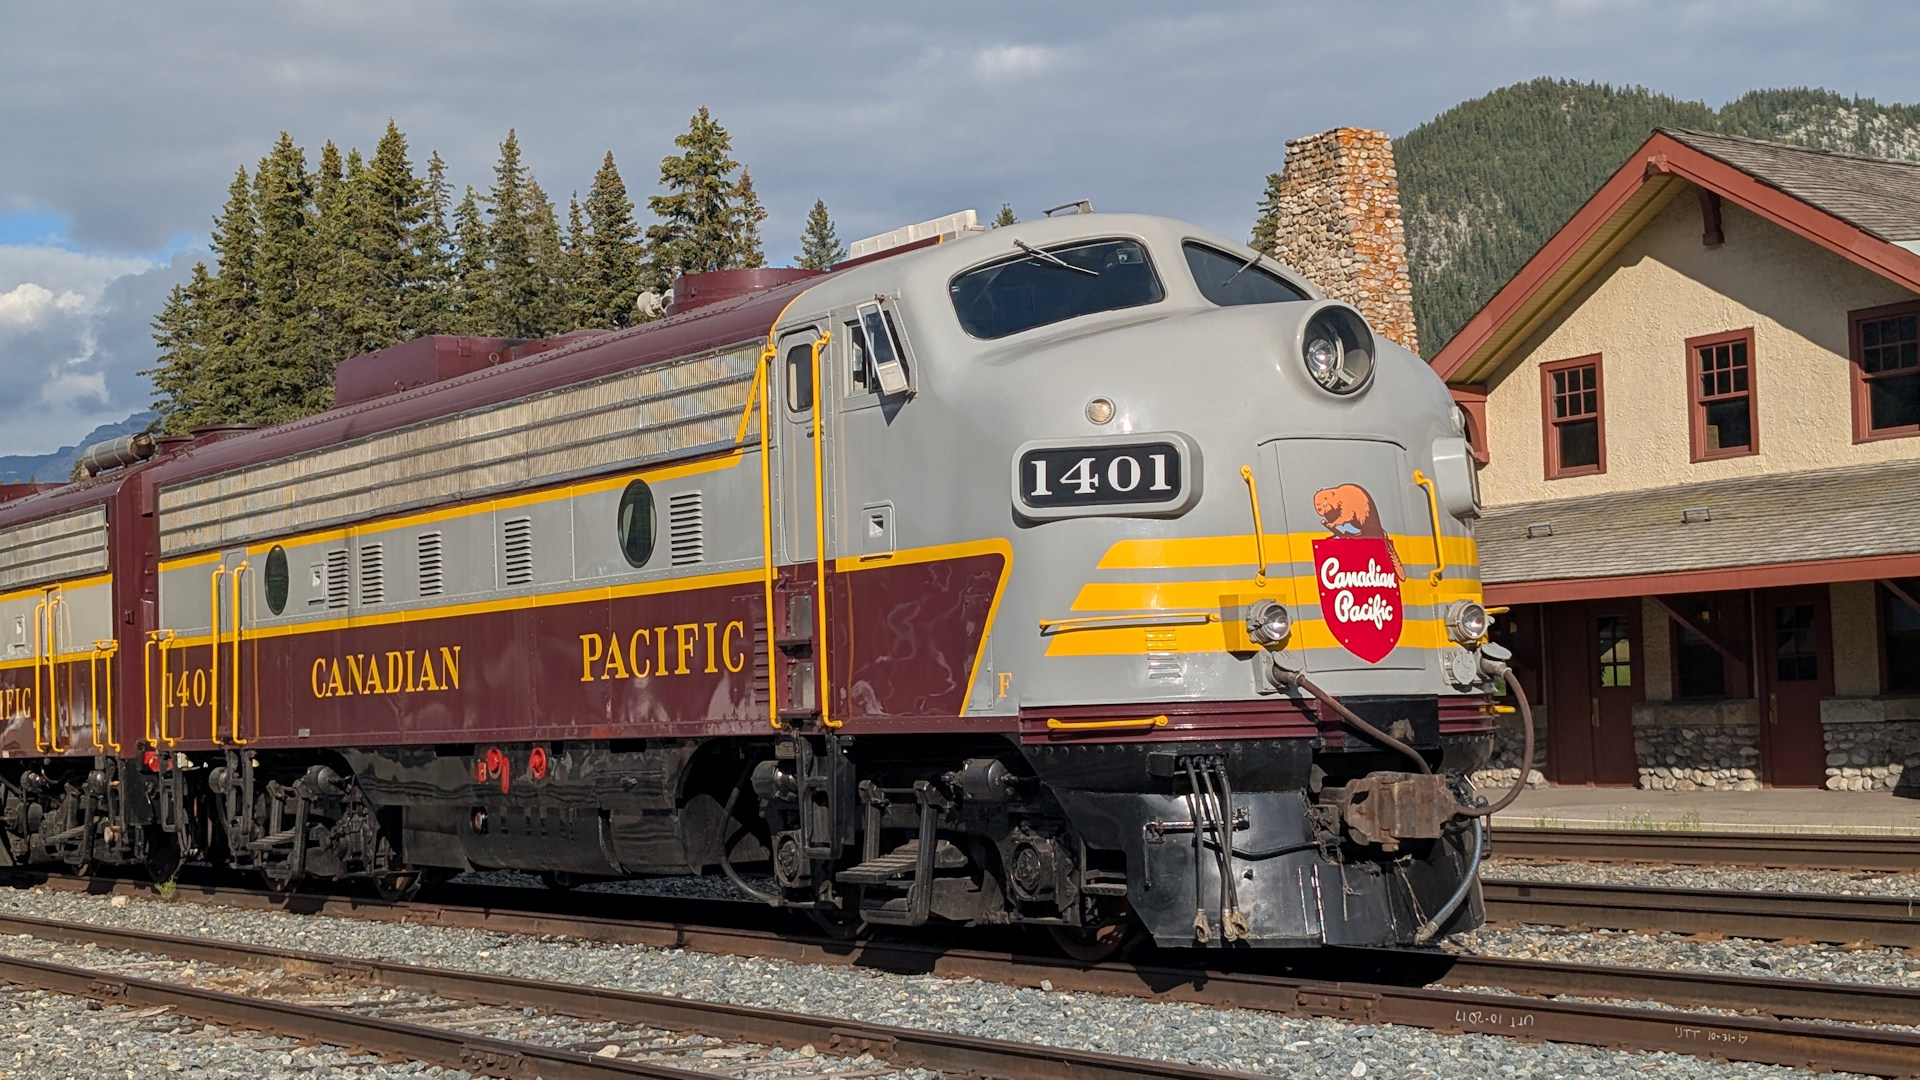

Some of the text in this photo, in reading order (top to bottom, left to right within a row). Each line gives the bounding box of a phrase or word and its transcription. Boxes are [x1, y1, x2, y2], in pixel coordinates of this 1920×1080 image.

[1030, 453, 1172, 496] 1401
[1320, 556, 1397, 590] Canadian
[1334, 589, 1393, 631] Pacific
[311, 620, 745, 698] CANADIAN PACIFIC
[997, 672, 1012, 698] F
